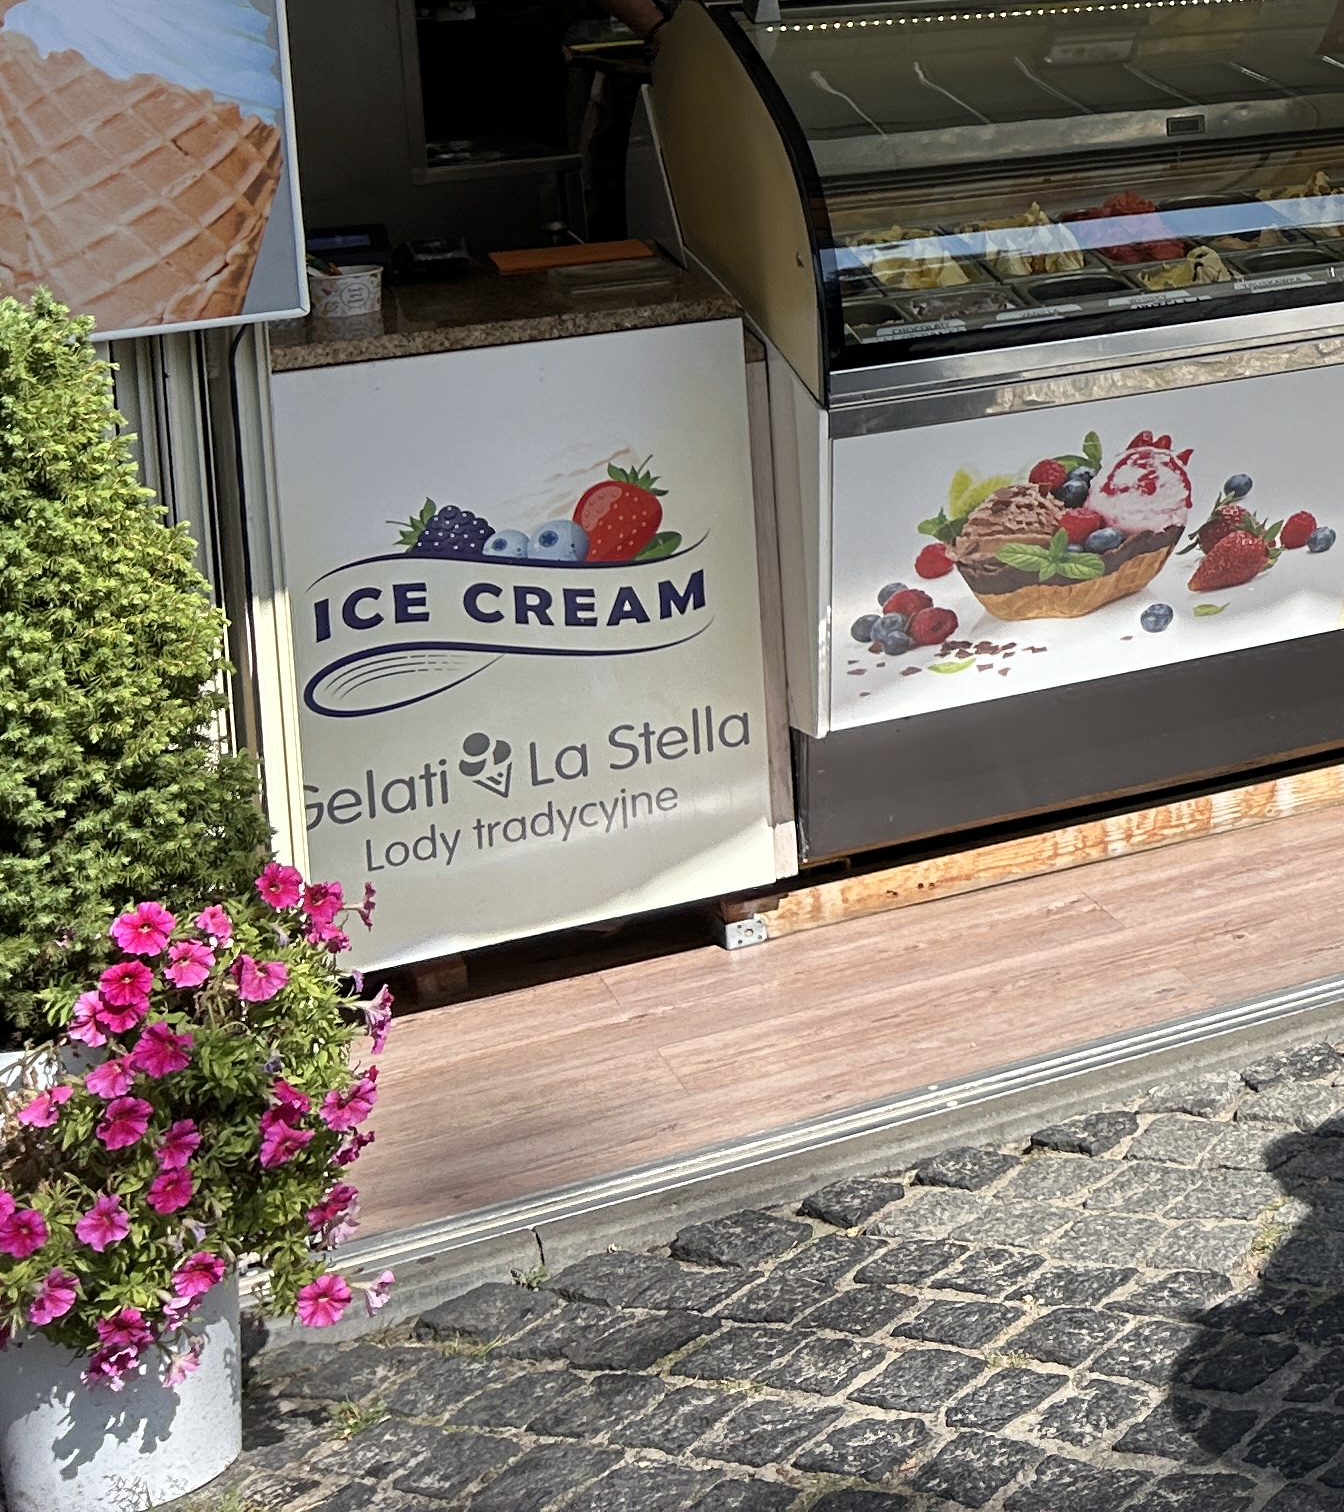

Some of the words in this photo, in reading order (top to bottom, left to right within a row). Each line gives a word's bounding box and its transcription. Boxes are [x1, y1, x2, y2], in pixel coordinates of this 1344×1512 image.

[315, 582, 430, 642] ICE
[463, 569, 706, 626] CREAM
[530, 741, 589, 787] La
[608, 705, 751, 771] Stella
[366, 823, 461, 872] Lody
[472, 787, 679, 849] tradycyjne
